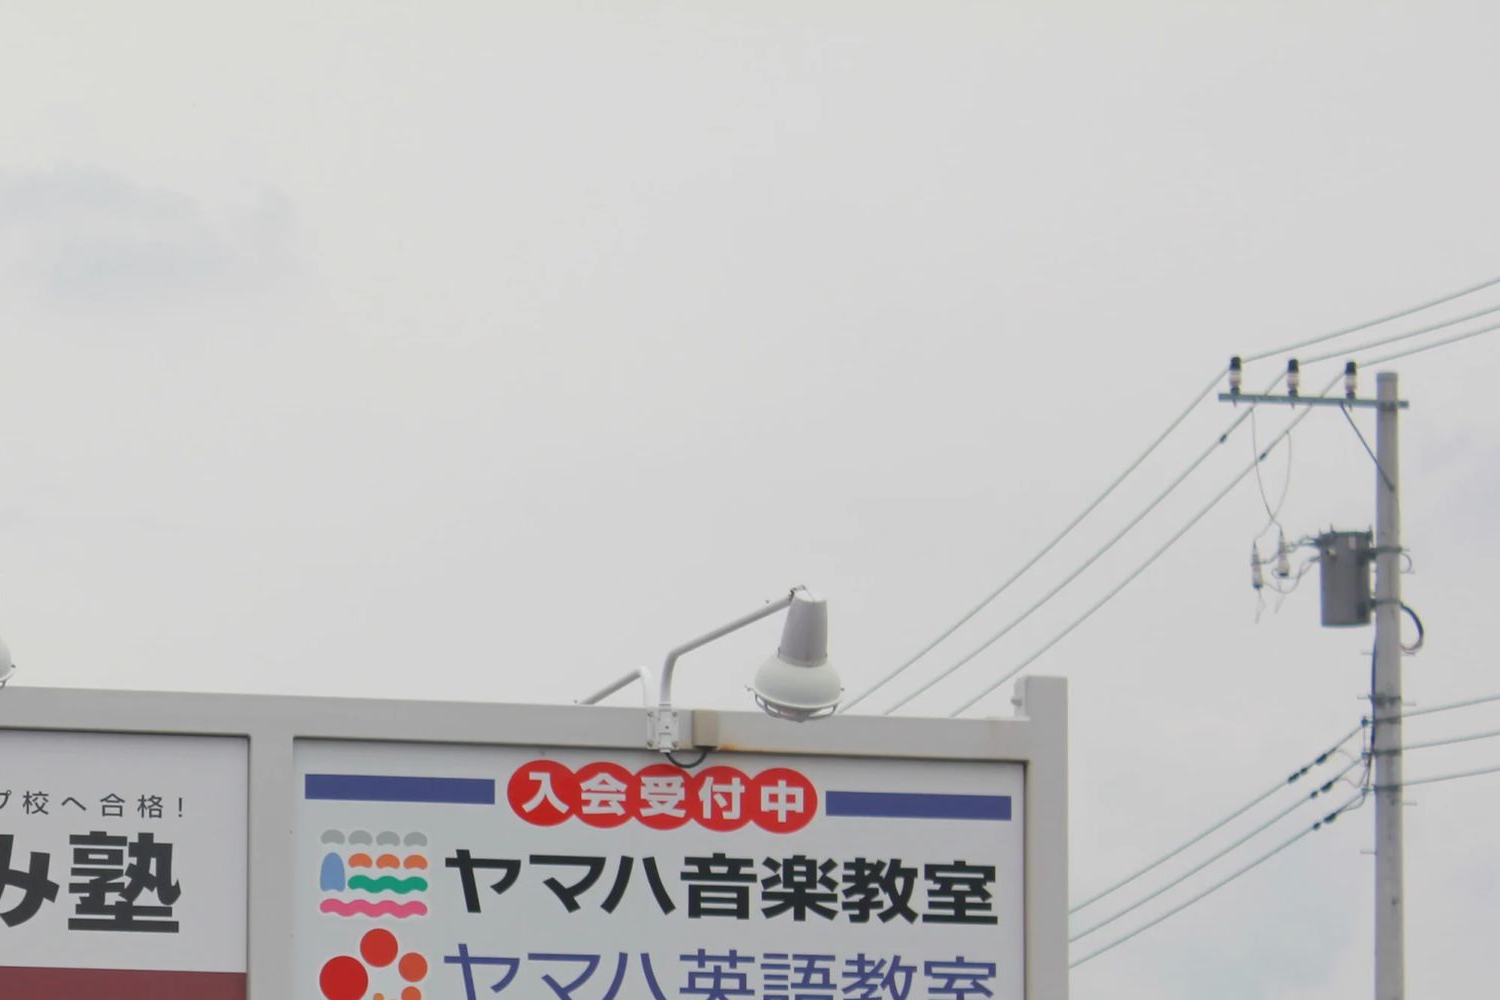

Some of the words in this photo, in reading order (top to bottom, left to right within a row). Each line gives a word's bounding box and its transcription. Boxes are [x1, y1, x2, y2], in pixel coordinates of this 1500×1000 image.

[522, 771, 805, 823] 入会受付中
[444, 849, 999, 926] ヤマハ音楽教室
